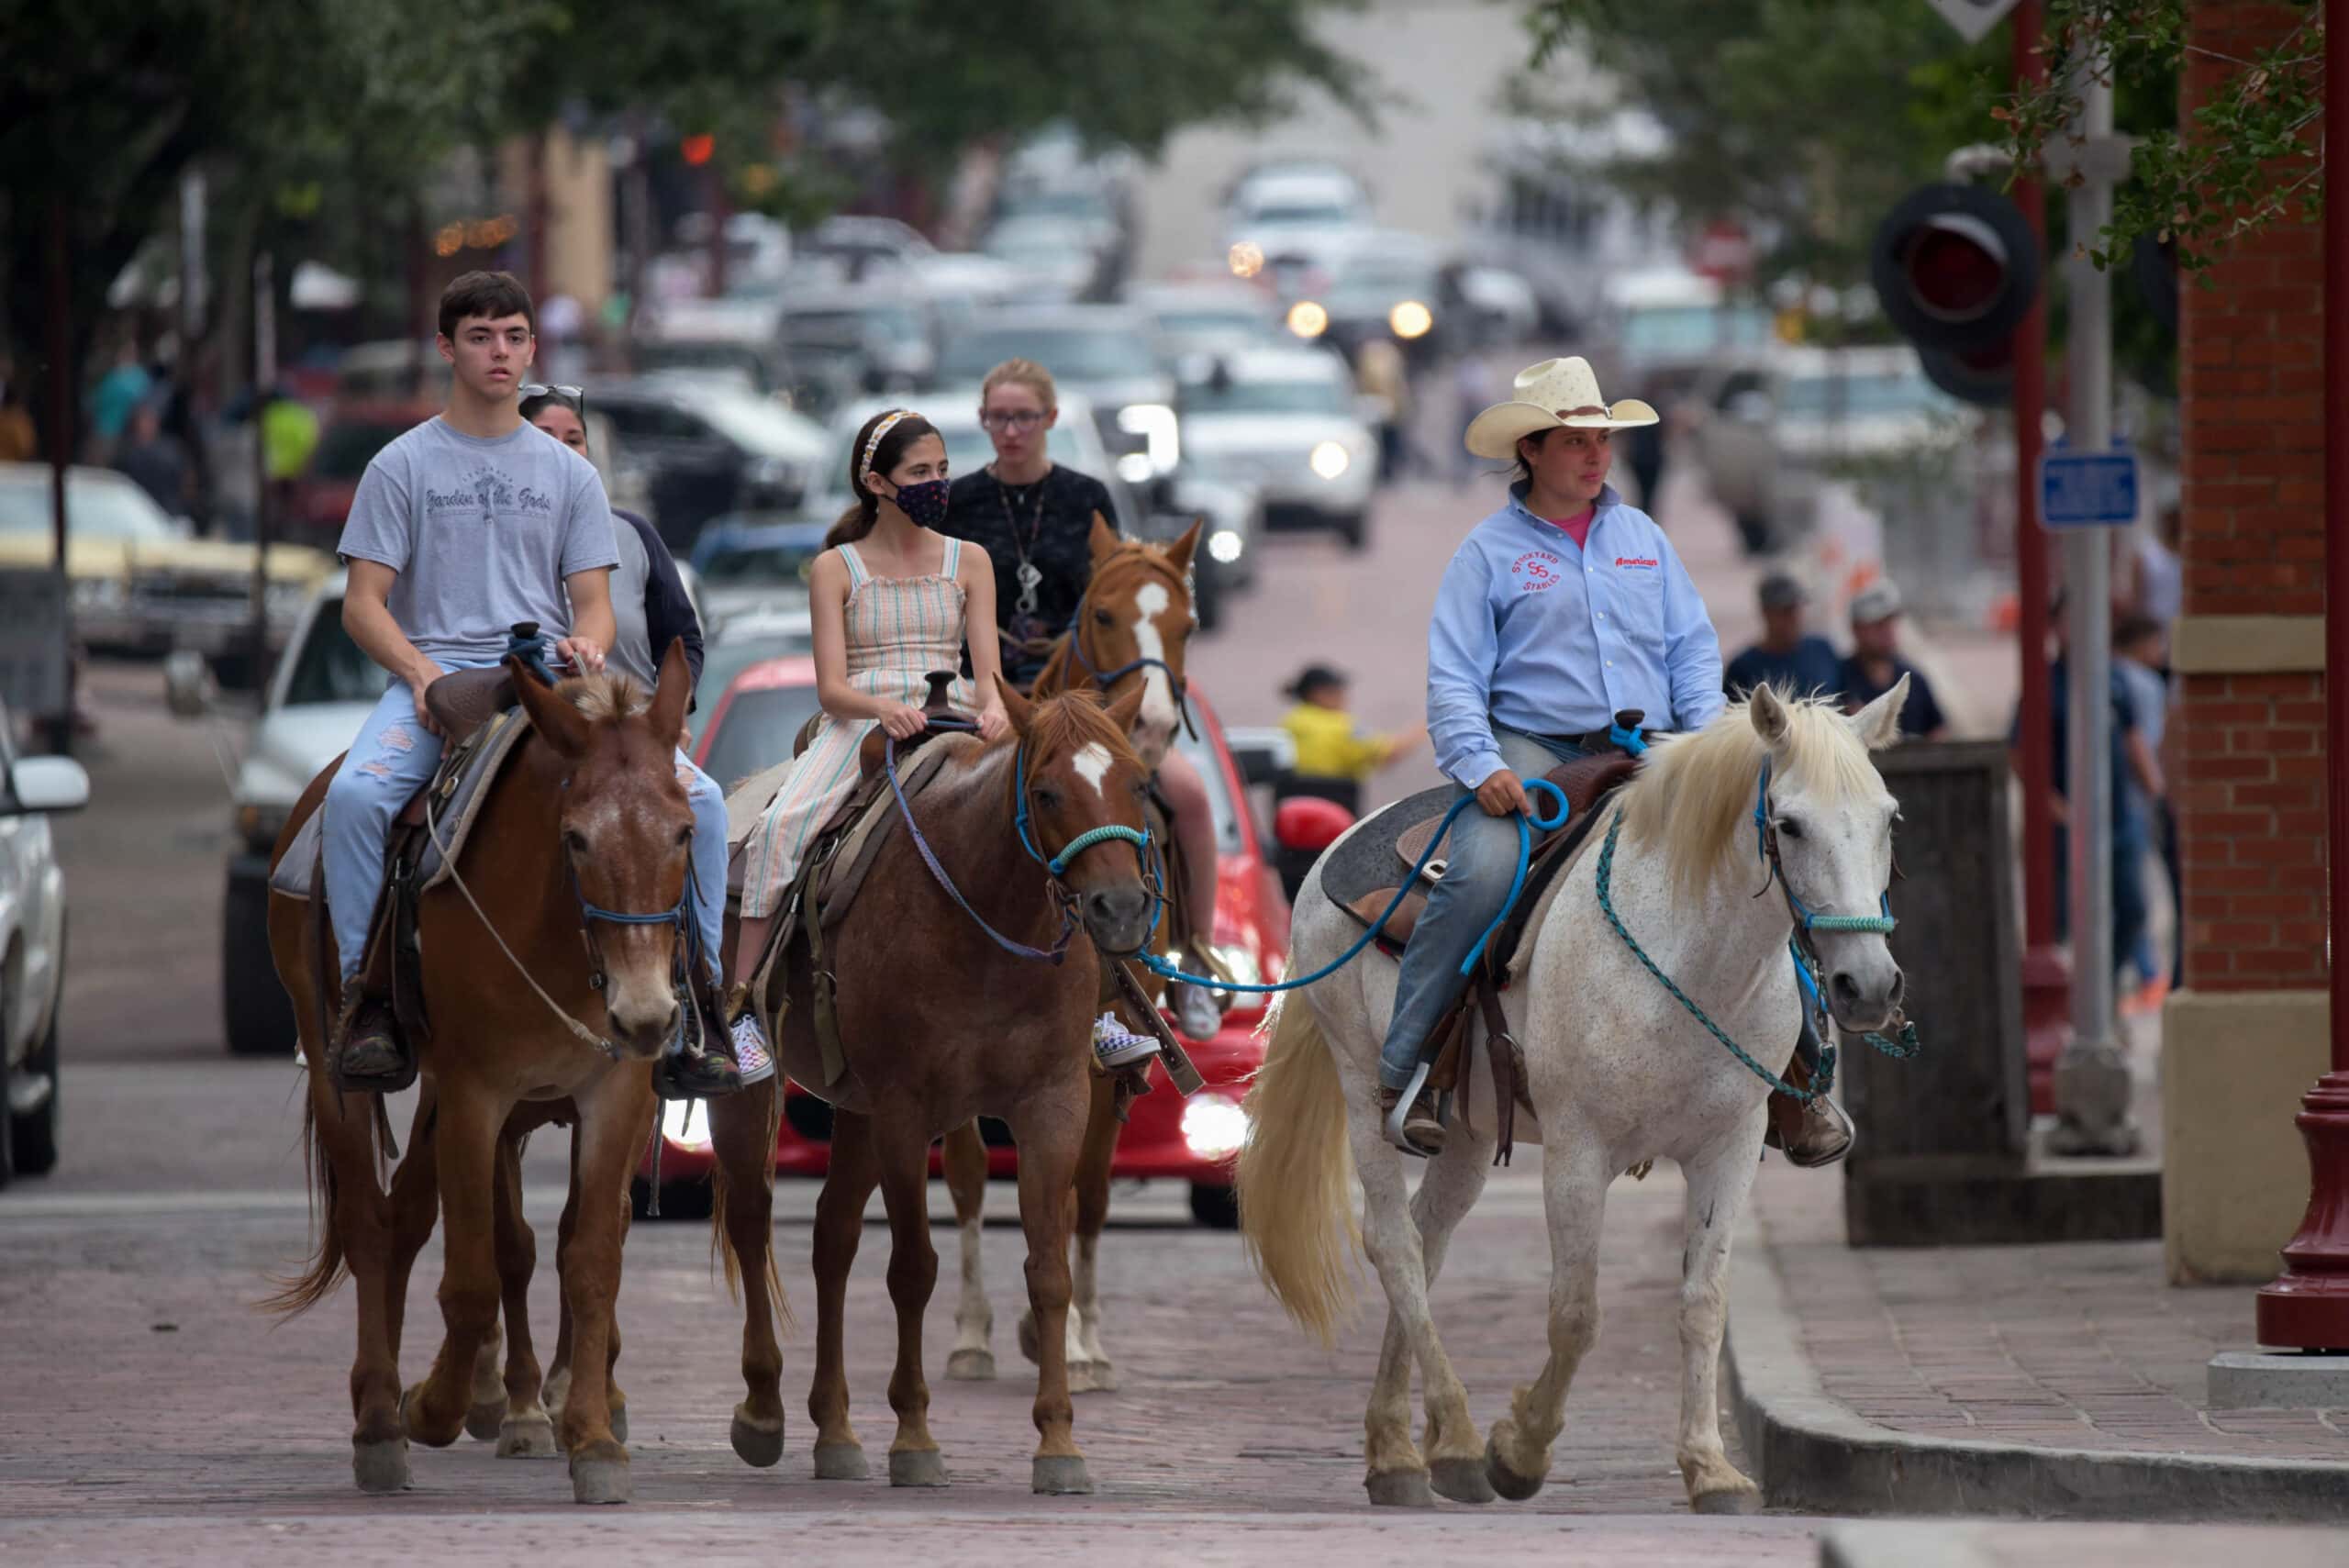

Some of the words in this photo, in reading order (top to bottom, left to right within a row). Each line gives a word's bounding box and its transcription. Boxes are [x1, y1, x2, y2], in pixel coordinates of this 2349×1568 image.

[426, 488, 474, 515] Garden
[493, 484, 513, 506] the
[518, 487, 551, 511] Gods
[1512, 551, 1559, 573] STOCKYARD
[1615, 556, 1658, 567] American
[1523, 574, 1561, 591] STABLES
